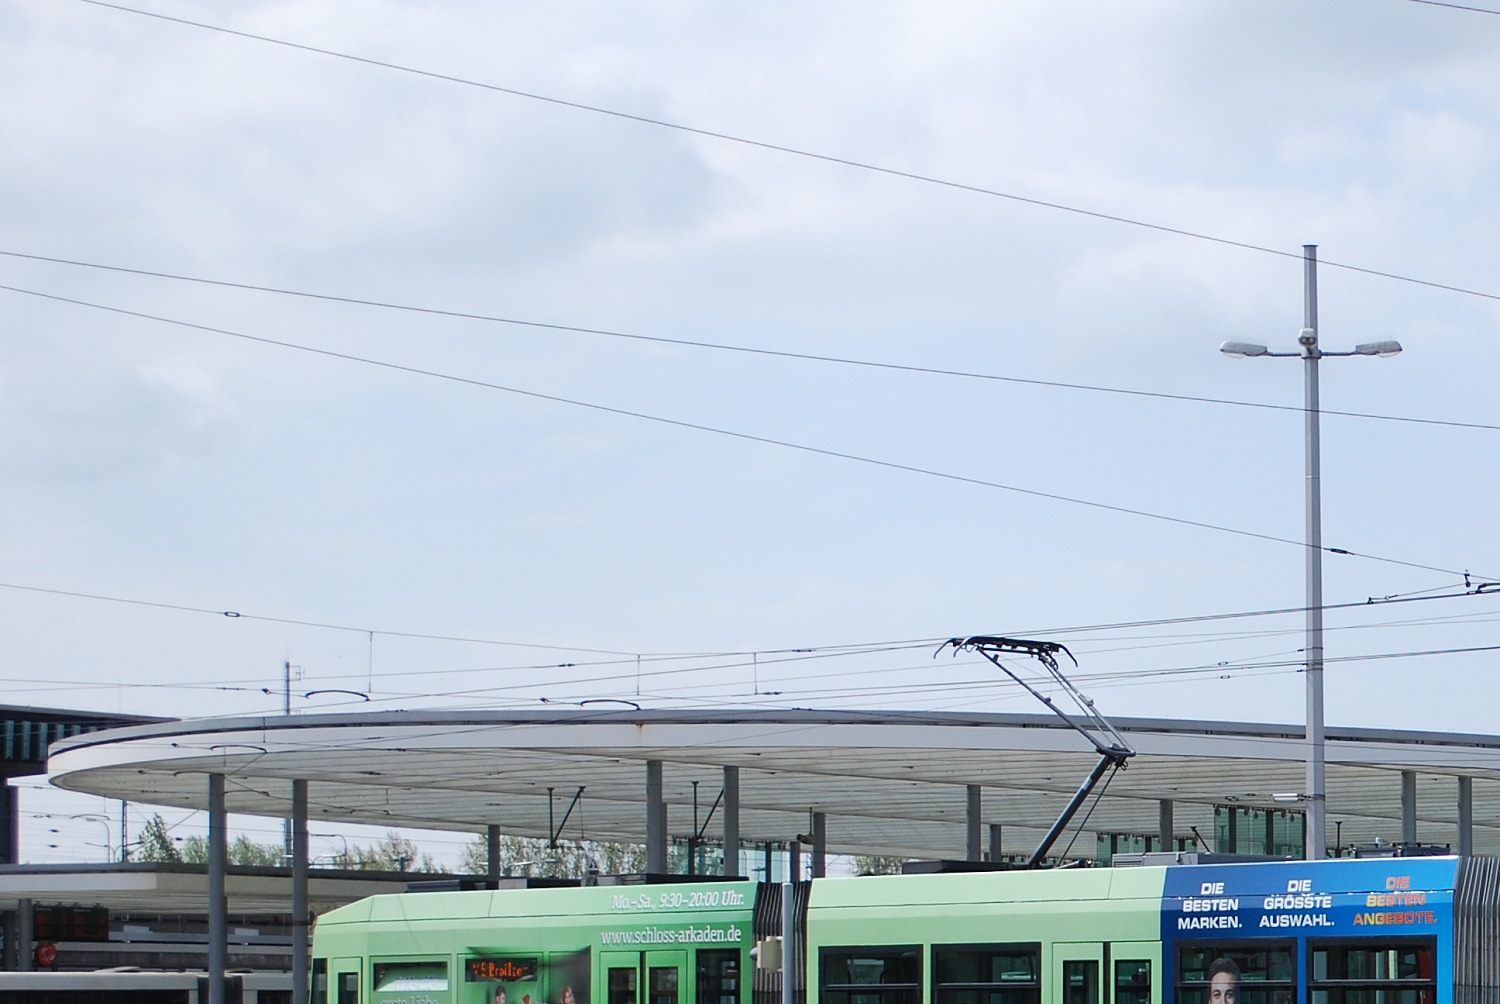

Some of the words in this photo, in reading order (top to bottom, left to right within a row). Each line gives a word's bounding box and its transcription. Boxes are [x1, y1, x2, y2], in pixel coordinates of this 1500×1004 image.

[1200, 882, 1225, 895] DIE
[1287, 879, 1312, 893] DIE
[1385, 876, 1411, 890] DIE
[721, 889, 745, 906] Uhr.
[1182, 898, 1239, 913] BESTEN
[1263, 894, 1333, 910] GRÖSSTE
[1366, 892, 1428, 907] BESTEN
[1178, 913, 1243, 930] MARKEN.
[1259, 913, 1335, 929] AUSWAHL.
[1353, 910, 1439, 926] ANGEBOTE.
[601, 924, 742, 944] www.schloss-arkaden.de
